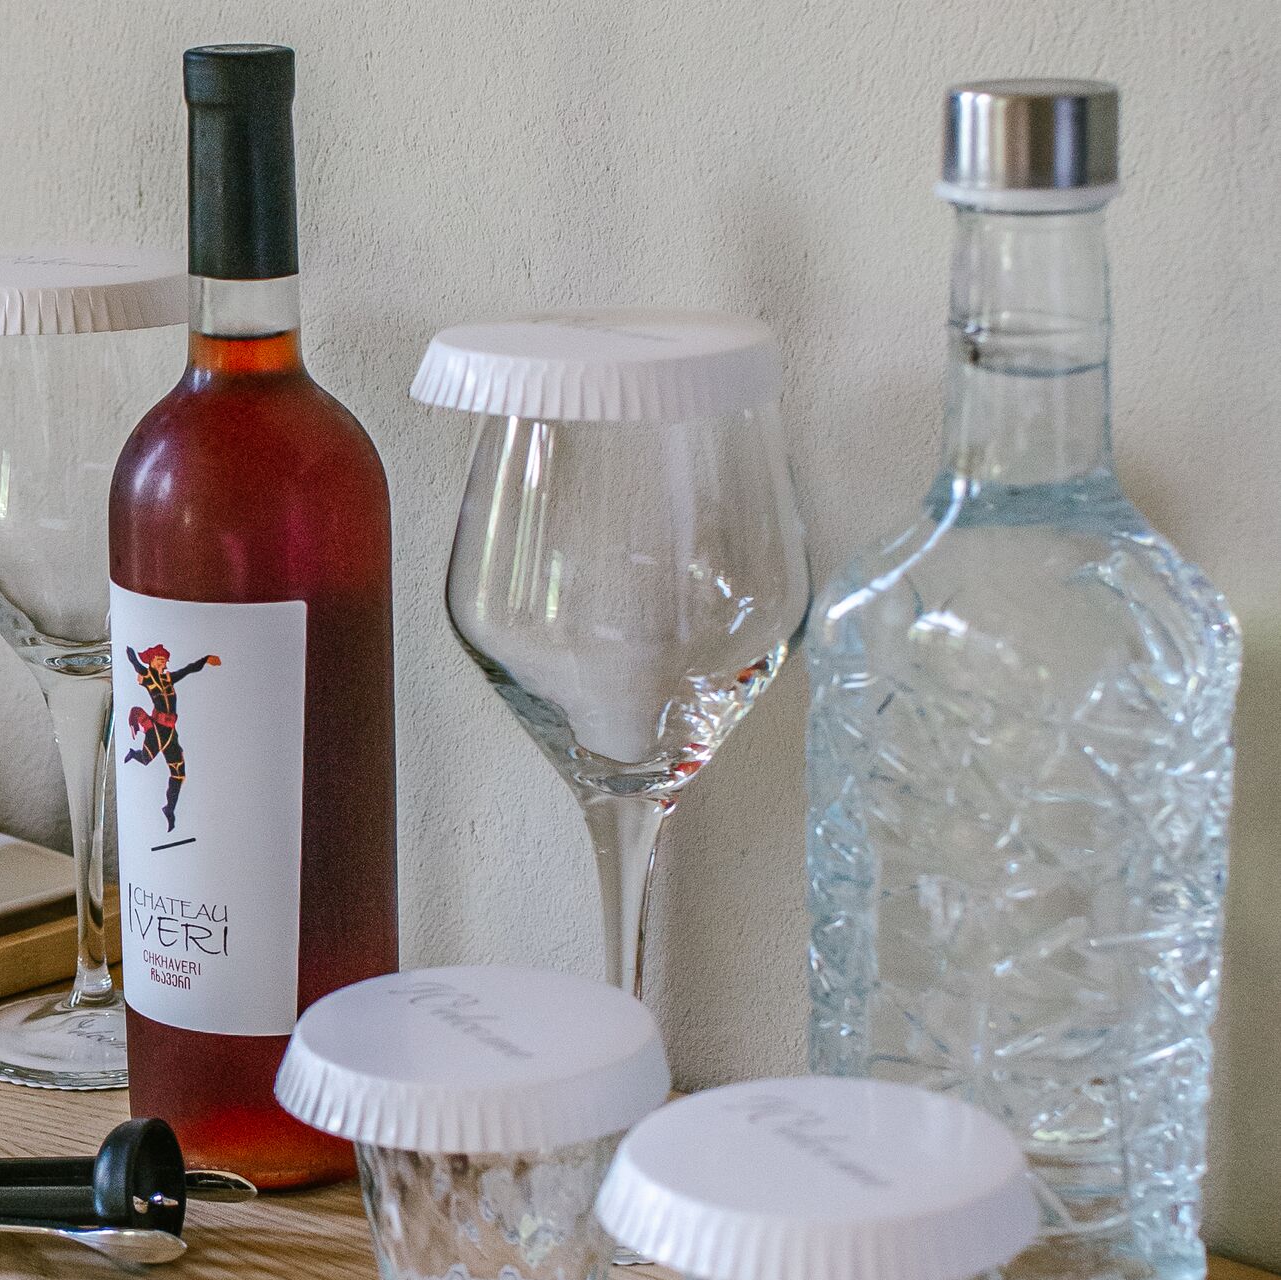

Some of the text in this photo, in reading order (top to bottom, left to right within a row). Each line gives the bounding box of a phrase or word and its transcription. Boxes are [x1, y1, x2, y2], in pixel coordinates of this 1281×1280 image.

[133, 886, 228, 923] CHATEAU
[142, 949, 201, 977] CHKHAVERI
[149, 967, 191, 991] ჩხავერი
